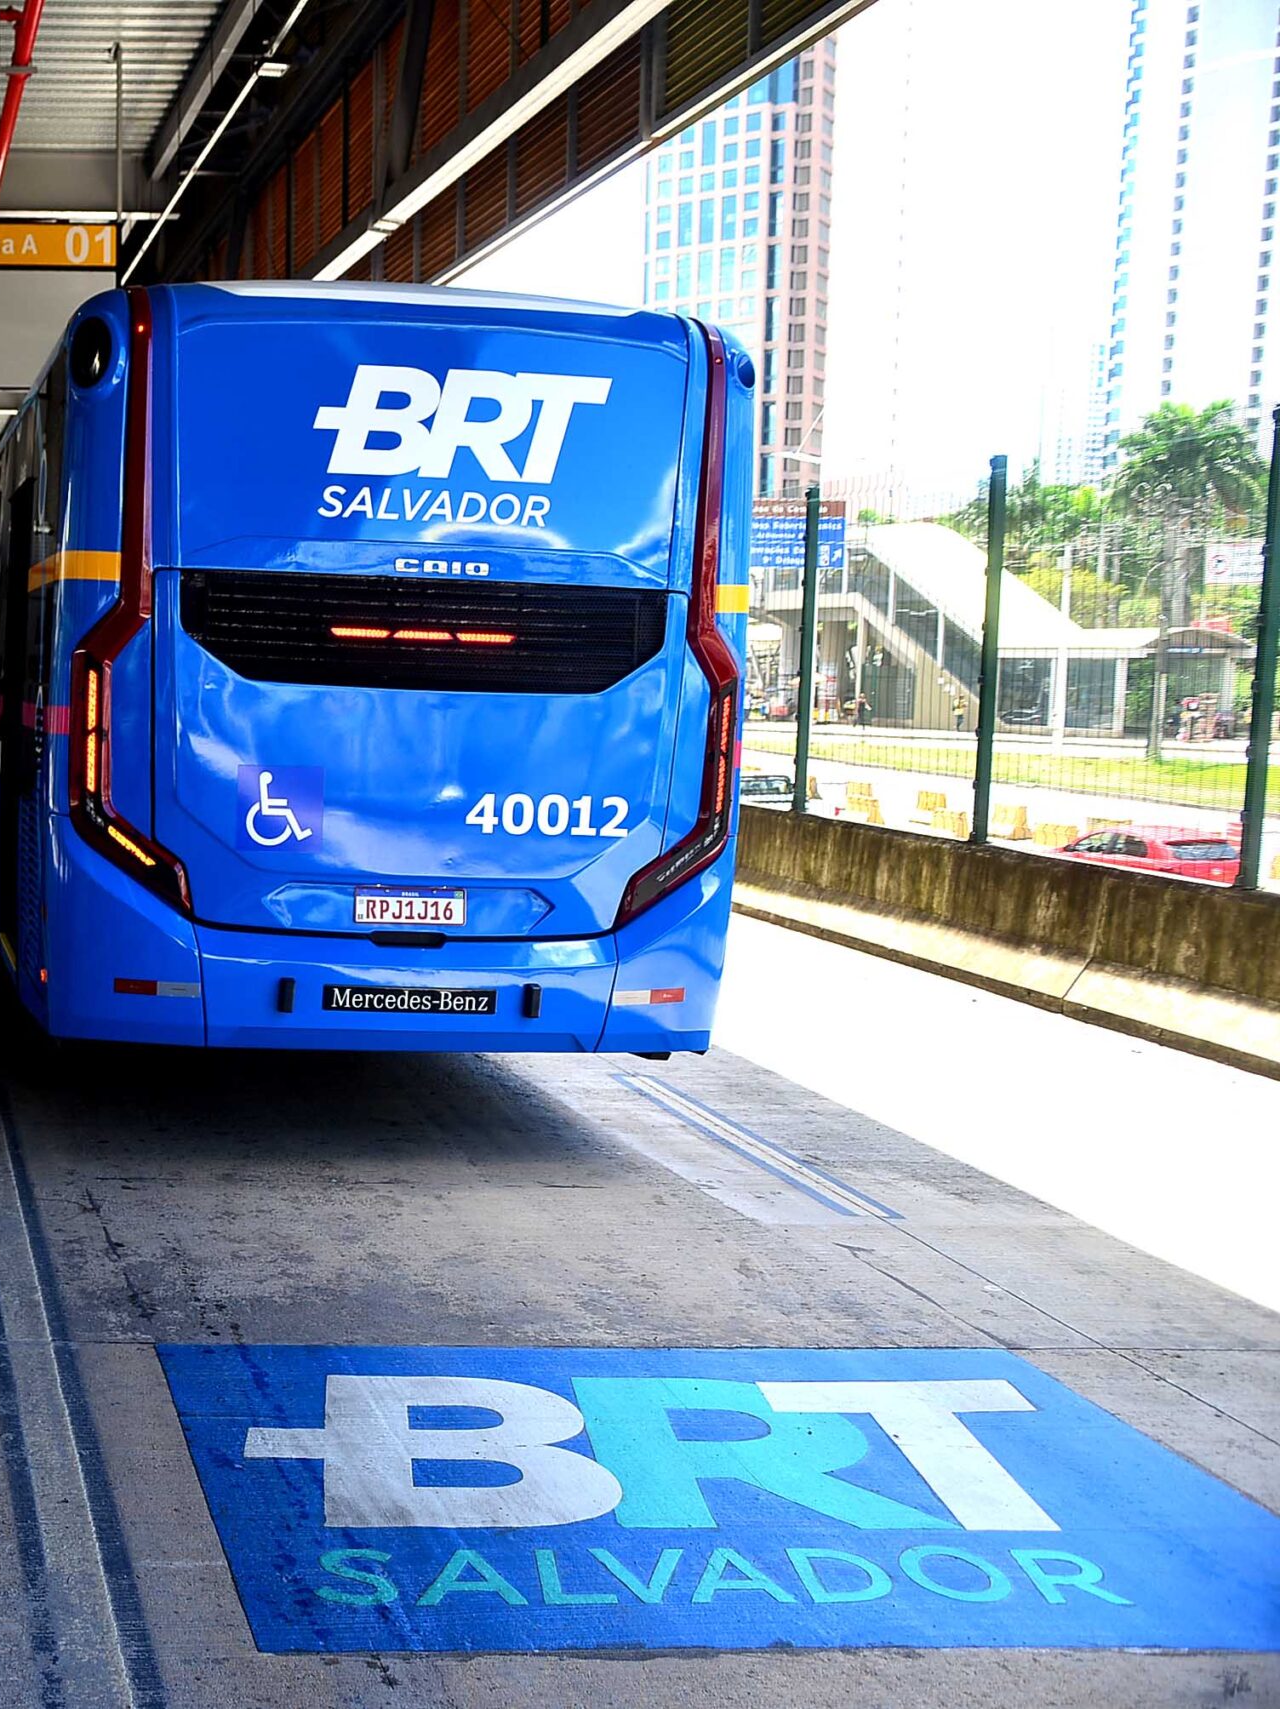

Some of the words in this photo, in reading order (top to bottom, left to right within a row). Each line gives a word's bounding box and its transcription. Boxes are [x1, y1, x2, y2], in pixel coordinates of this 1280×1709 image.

[21, 233, 38, 255] A
[65, 225, 112, 264] 01
[313, 364, 613, 484] BRT
[317, 485, 551, 528] SALVADOR
[395, 558, 490, 577] CAIO
[465, 792, 630, 838] 40012
[366, 899, 453, 921] RPJ1J16
[331, 987, 489, 1012] Mercedes-Benz
[243, 1373, 1062, 1533] BRT
[315, 1546, 1135, 1608] SALVADOR
